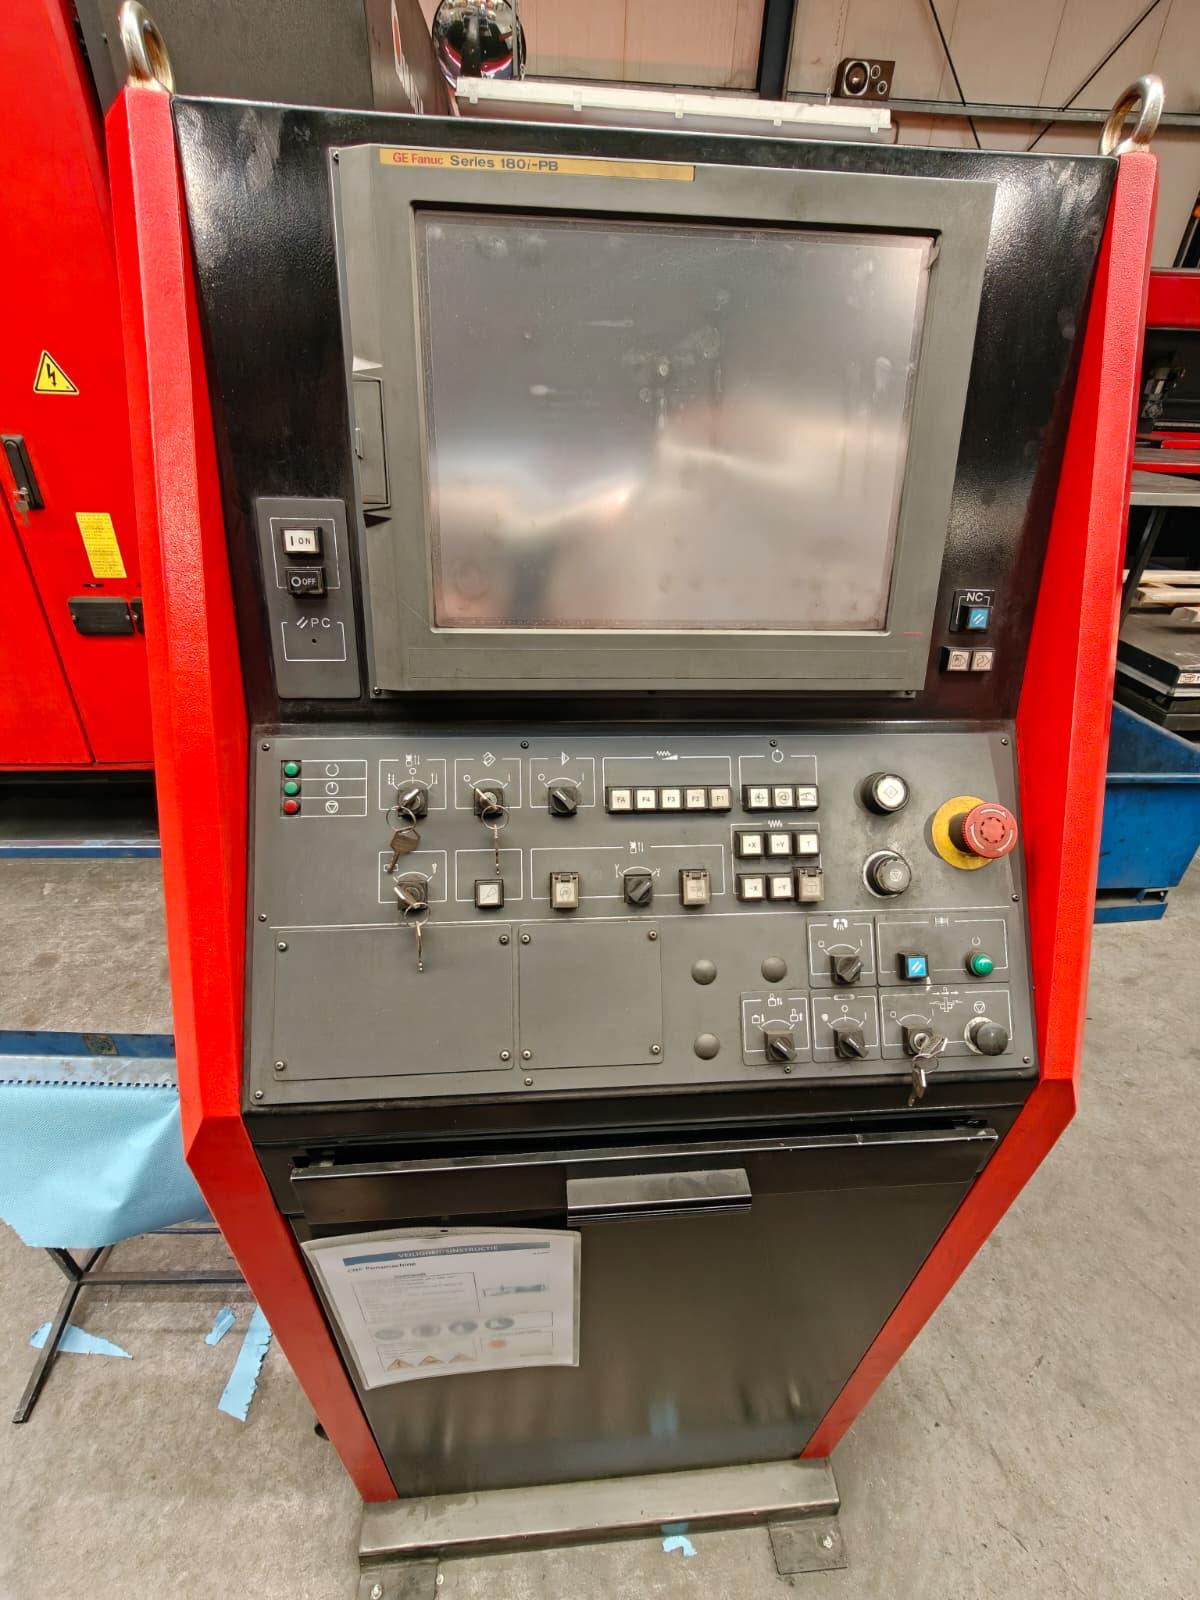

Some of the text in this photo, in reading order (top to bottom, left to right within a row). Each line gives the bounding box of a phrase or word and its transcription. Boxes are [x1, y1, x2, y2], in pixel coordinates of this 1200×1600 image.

[392, 151, 409, 164] GE
[411, 153, 444, 165] Fanuc
[450, 154, 495, 168] Series
[298, 537, 311, 545] ON
[302, 577, 316, 586] OFF
[966, 592, 984, 602] NC
[310, 617, 331, 628] PC
